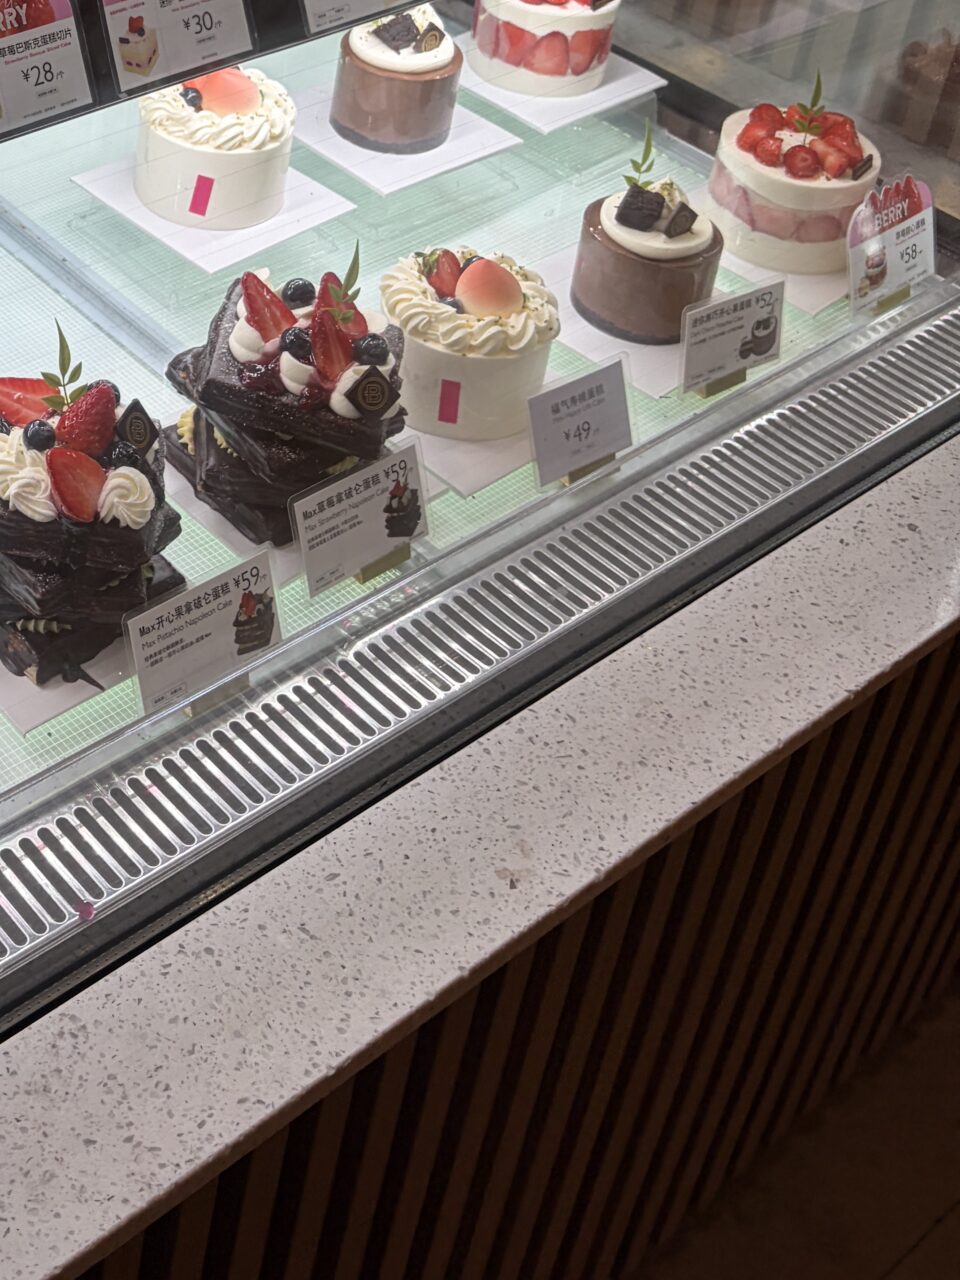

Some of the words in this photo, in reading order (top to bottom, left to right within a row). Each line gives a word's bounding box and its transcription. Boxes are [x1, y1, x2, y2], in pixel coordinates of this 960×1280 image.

[875, 199, 909, 229] BERRY
[899, 240, 922, 266] ¥58
[563, 415, 599, 447] ¥49
[383, 455, 413, 486] ¥59
[138, 580, 230, 640] Max开心果拿破仑蛋糕
[141, 637, 156, 651] Max
[156, 622, 184, 643] Pistachio
[185, 606, 216, 629] Napoleon
[217, 597, 232, 611] Cake
